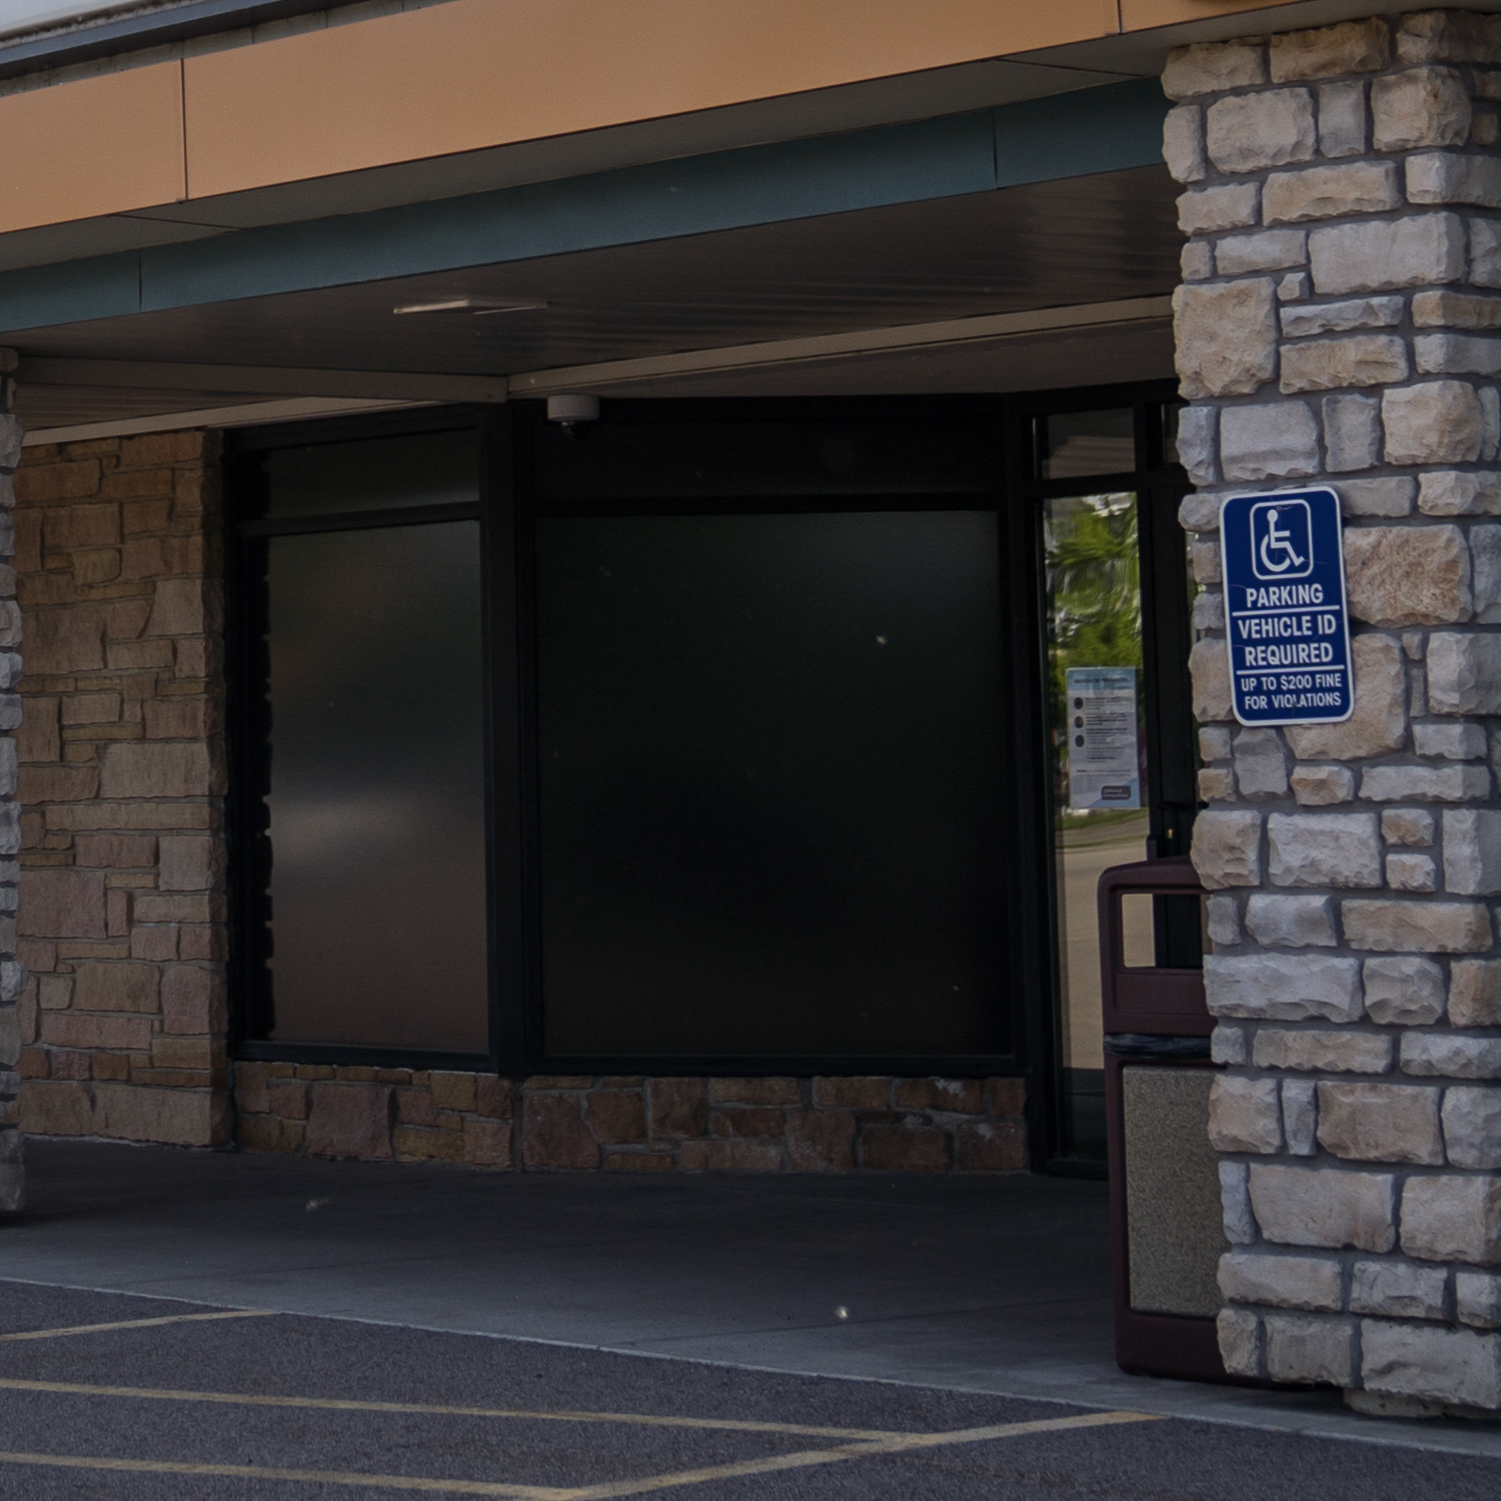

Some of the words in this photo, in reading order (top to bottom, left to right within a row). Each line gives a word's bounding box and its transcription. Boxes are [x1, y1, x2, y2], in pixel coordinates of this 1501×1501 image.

[1245, 582, 1324, 609] PARKING
[1238, 614, 1313, 640] VEHICLE
[1316, 613, 1337, 636] ID
[1244, 641, 1334, 667] REQUIRED
[1240, 677, 1258, 692] UP
[1260, 676, 1278, 691] TO
[1280, 674, 1313, 691] $200
[1314, 673, 1343, 688] FINE
[1244, 695, 1269, 711] FOR
[1271, 692, 1342, 709] VIOLATIONS
